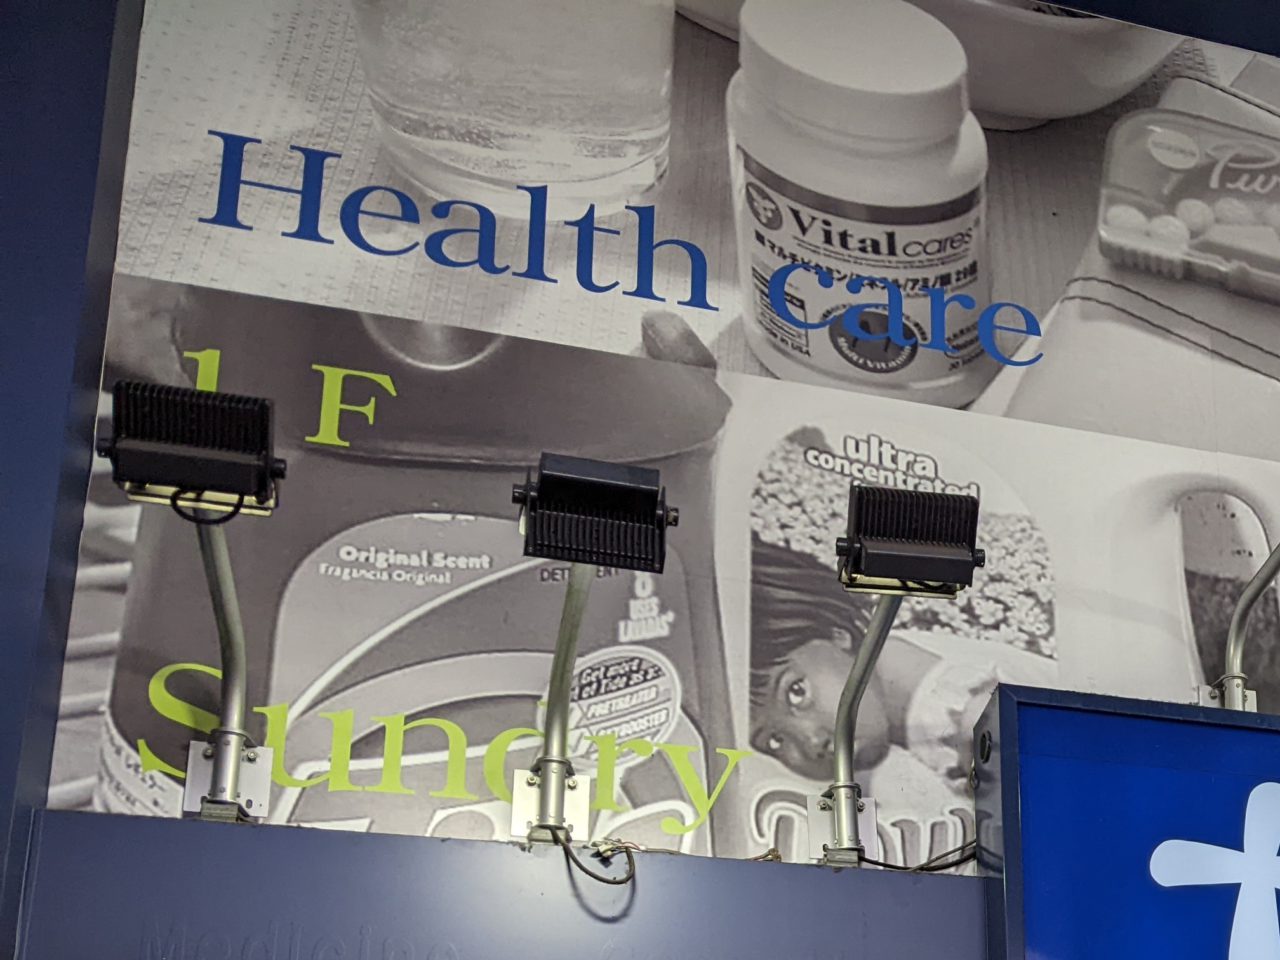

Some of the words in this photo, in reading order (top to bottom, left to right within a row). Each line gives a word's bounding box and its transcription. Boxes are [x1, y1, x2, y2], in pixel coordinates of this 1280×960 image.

[198, 130, 718, 311] Health
[768, 262, 1043, 367] care
[788, 204, 898, 258] Vital
[902, 226, 973, 258] cares
[304, 364, 397, 447] F
[804, 447, 980, 498] concentrated
[844, 434, 938, 478] ultra
[338, 545, 428, 569] Original
[433, 549, 492, 571] Scent
[393, 567, 452, 585] Original
